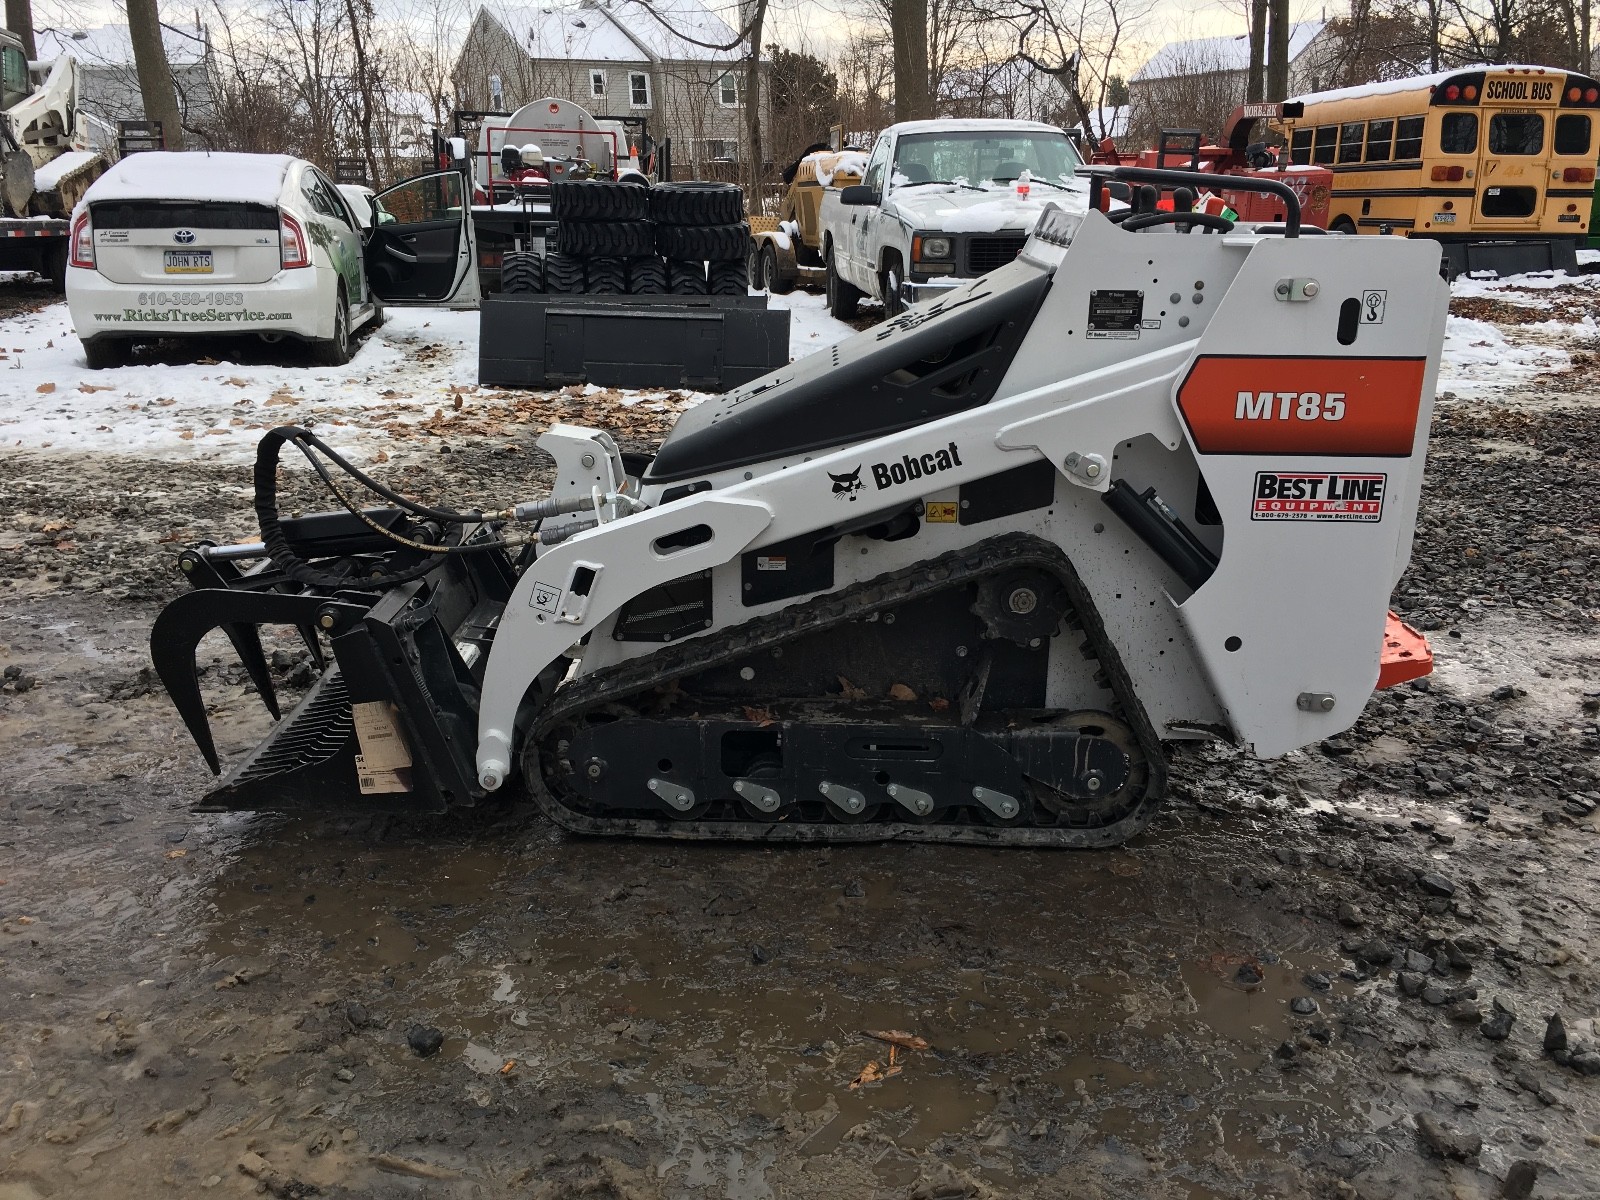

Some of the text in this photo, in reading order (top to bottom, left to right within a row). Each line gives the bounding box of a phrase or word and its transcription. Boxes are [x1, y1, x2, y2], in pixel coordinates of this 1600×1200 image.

[1487, 81, 1553, 100] SCHOOL BUS
[167, 256, 210, 267] JOHN RTS
[138, 292, 243, 305] 610-358-1953
[94, 308, 292, 322] www.RicksTreeService.com
[1235, 391, 1346, 421] MT85
[871, 442, 962, 490] Bobcat
[1257, 474, 1383, 500] BEST LINE
